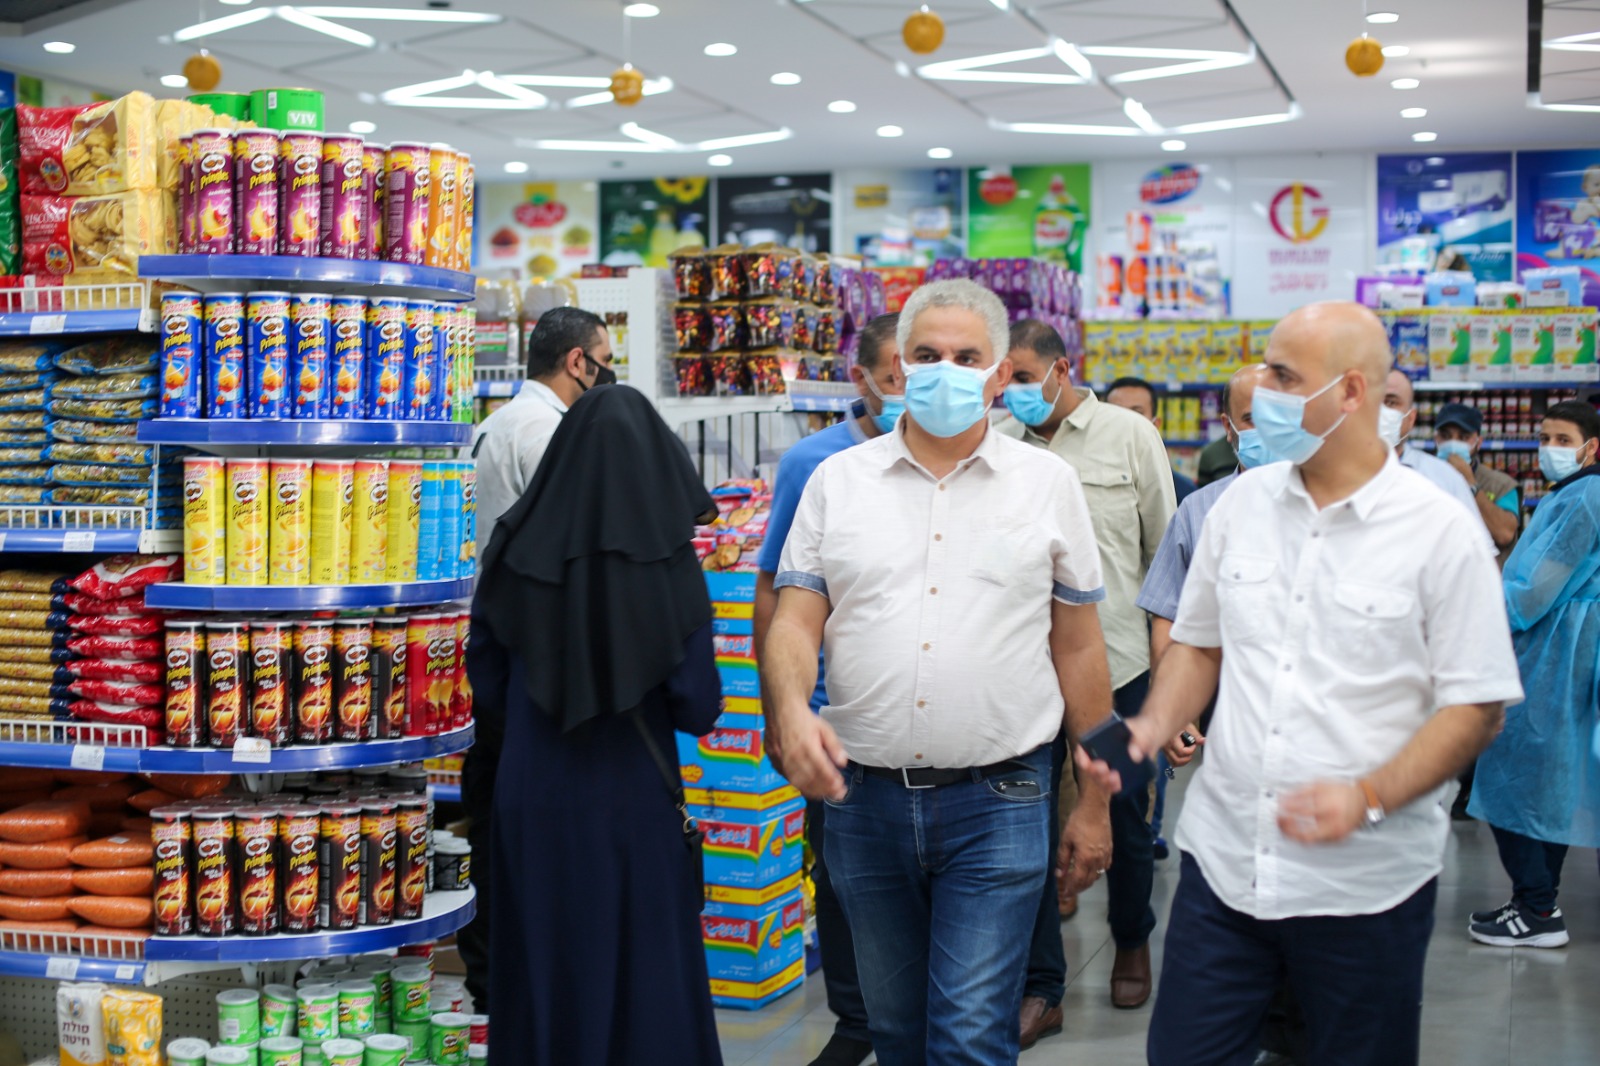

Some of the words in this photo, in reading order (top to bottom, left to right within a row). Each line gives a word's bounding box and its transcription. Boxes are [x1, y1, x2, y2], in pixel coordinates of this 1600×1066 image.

[200, 170, 229, 190] Pringles
[249, 170, 277, 190] Pringles
[292, 172, 320, 191] Pringles
[164, 332, 192, 351] Pringles
[215, 333, 243, 354] Pringles
[260, 334, 286, 353] Pringles
[298, 335, 326, 354] Pringles
[335, 337, 362, 355] Pringles
[303, 661, 330, 681] Pringles
[344, 660, 370, 680] Pringles
[156, 855, 185, 874] Pringles
[198, 854, 226, 873] Pringles
[245, 852, 273, 872] Pringles
[289, 851, 317, 871] Pringles
[62, 1021, 90, 1033] סולת
[62, 1034, 90, 1046] חיטה
